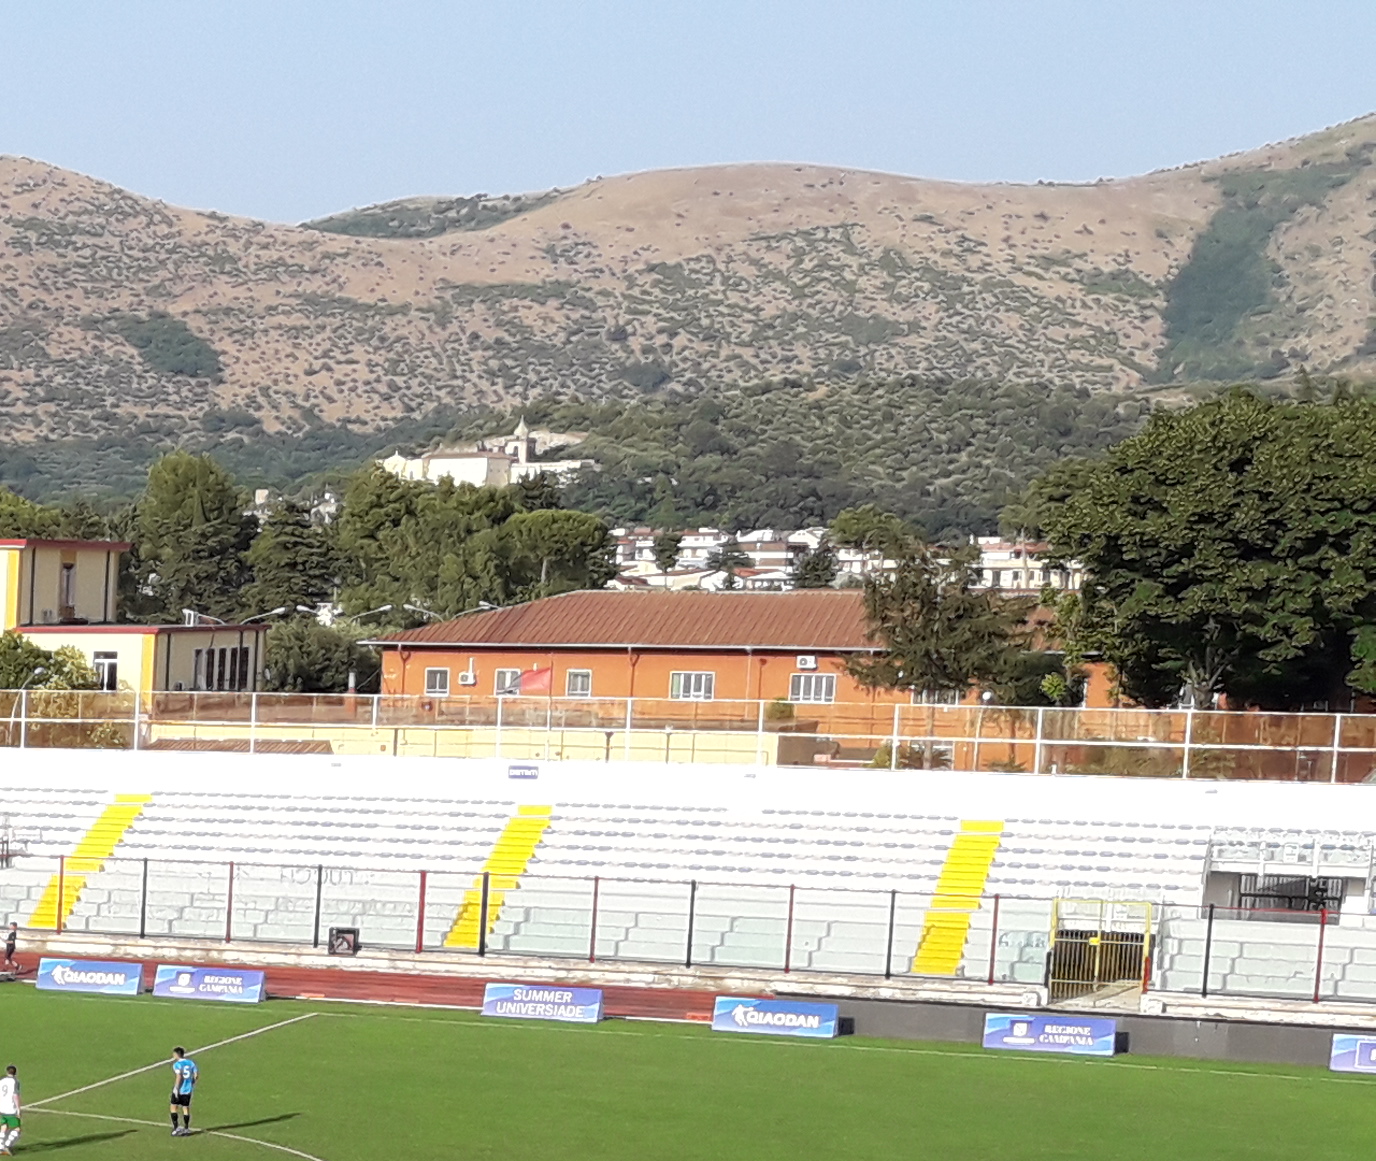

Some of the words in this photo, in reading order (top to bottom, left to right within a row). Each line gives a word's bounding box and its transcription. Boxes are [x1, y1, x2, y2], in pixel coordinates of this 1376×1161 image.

[65, 969, 125, 986] QIAODAN
[513, 989, 572, 1003] SUMMER
[496, 1001, 584, 1018] UNIVERSIADE
[747, 1011, 820, 1029] QIAODAN
[1044, 1025, 1090, 1036] REGIONE
[1039, 1034, 1094, 1046] CAMPANIA
[182, 1065, 191, 1079] 5
[2, 1084, 9, 1097] 9
